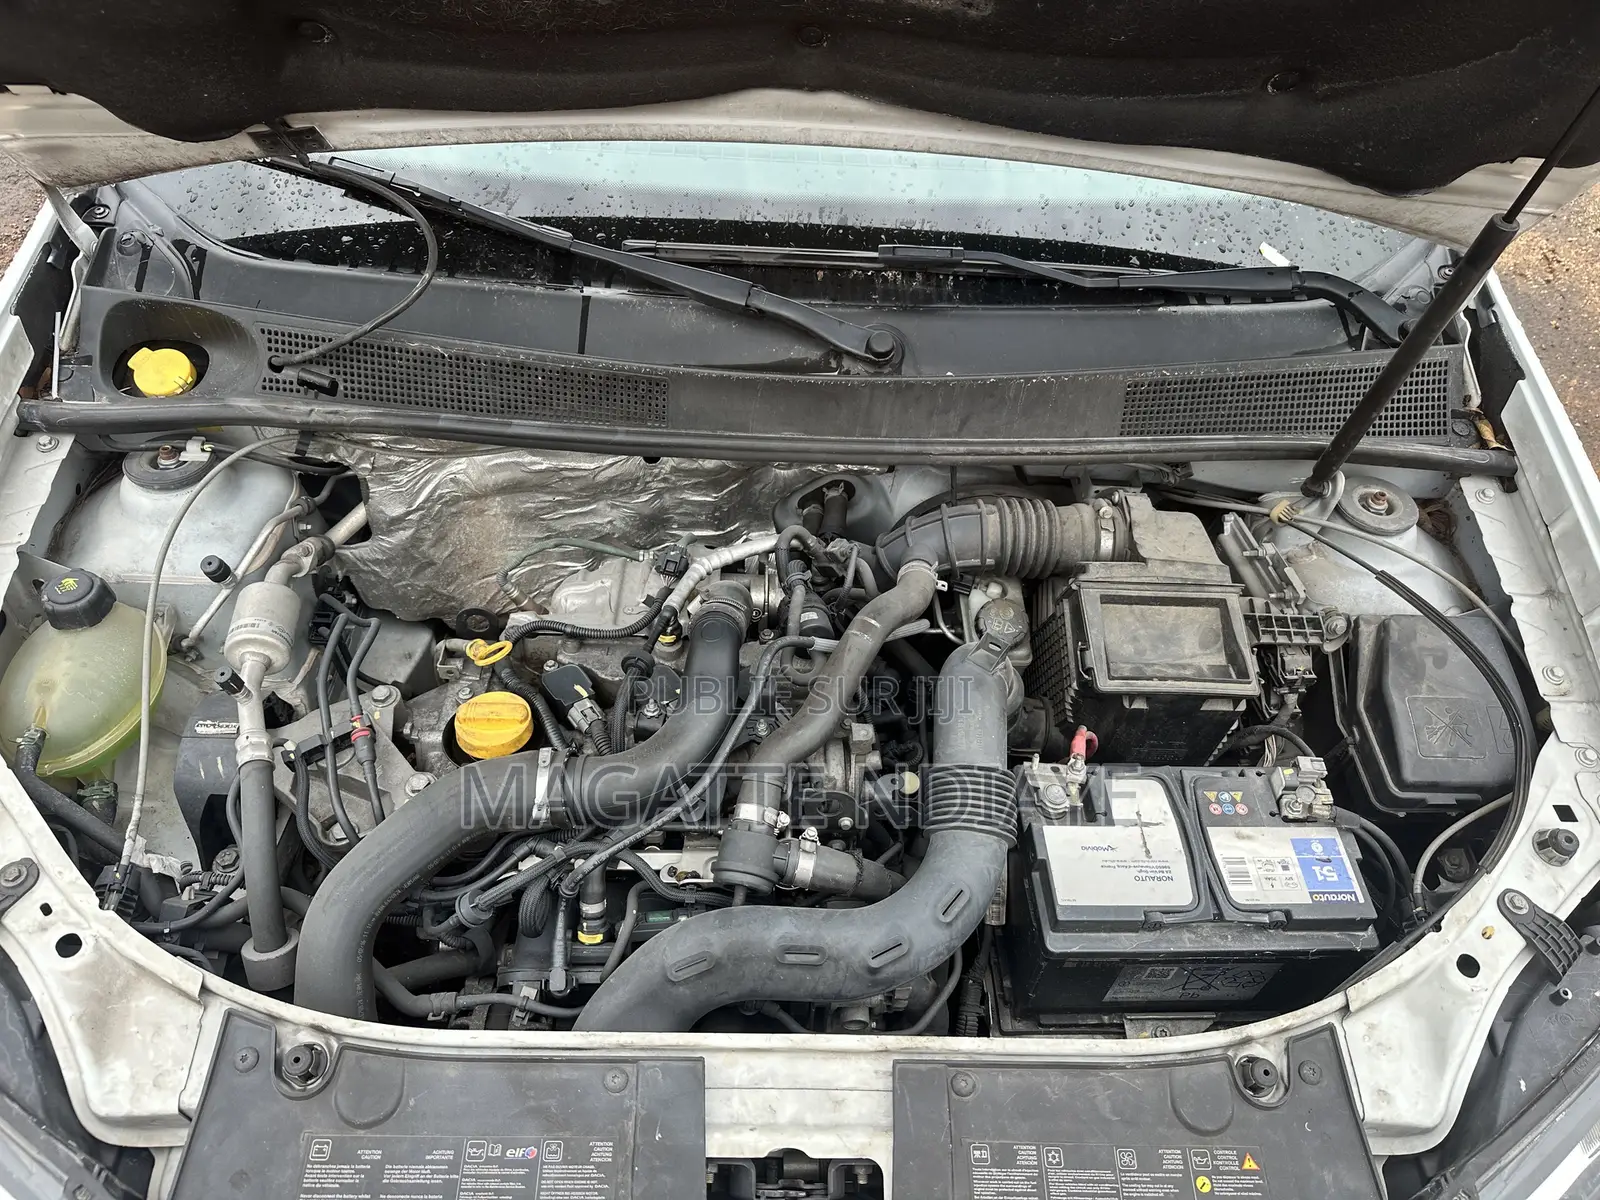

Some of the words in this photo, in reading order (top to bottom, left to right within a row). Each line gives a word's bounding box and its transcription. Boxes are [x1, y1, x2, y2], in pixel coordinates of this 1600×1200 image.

[1081, 845, 1110, 853] Mobivia
[1312, 865, 1340, 882] 51
[1312, 893, 1356, 902] Norauto
[505, 1147, 526, 1158] elf
